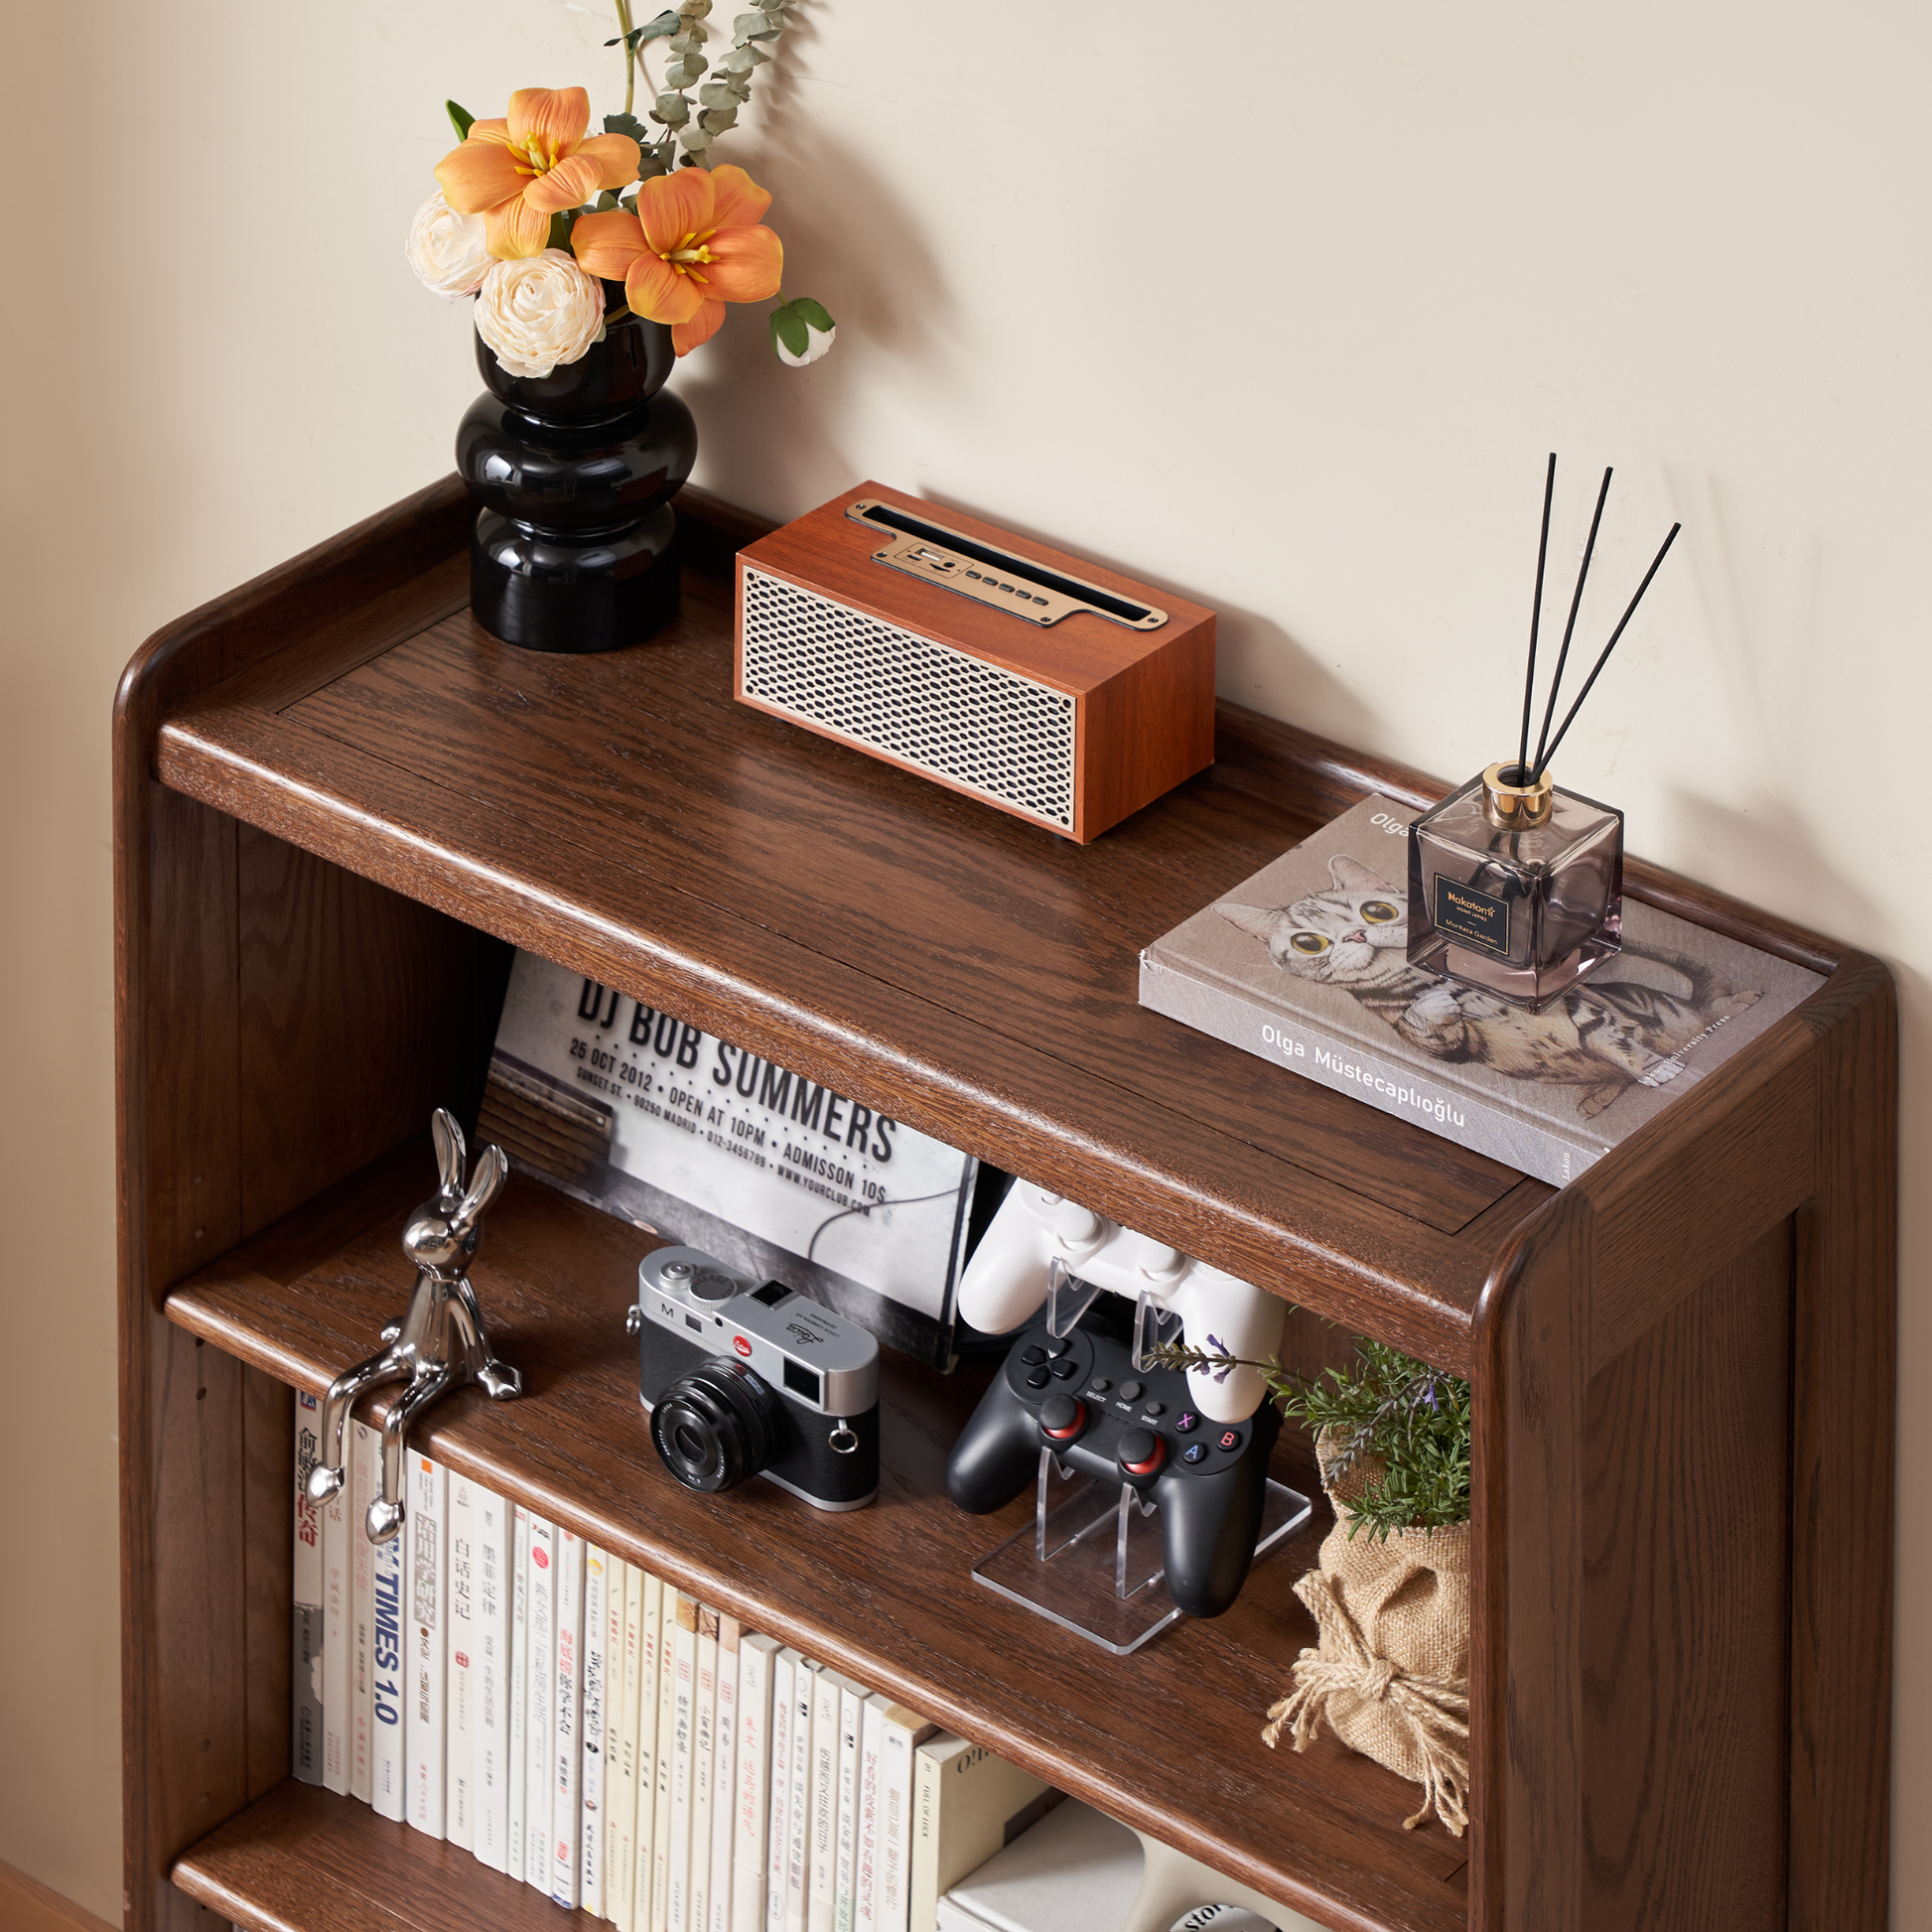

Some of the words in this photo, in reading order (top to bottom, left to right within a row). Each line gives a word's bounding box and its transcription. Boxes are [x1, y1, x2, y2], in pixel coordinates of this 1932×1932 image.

[1448, 892, 1496, 917] Nakatomi
[1474, 930, 1498, 945] Garden
[1262, 1025, 1305, 1057] Olga
[1664, 1033, 1709, 1065] University
[1706, 1015, 1730, 1033] Press
[578, 978, 620, 1029] DJ
[628, 1003, 702, 1069] BOB
[713, 1041, 897, 1163] SUMMERS
[570, 1038, 588, 1059] 25
[591, 1048, 617, 1073] OCT
[619, 1062, 652, 1092] 2012
[669, 1087, 704, 1117] OPEN
[707, 1106, 725, 1127] AT
[731, 1117, 765, 1148] 10PM
[782, 1143, 855, 1189] ADMISSON
[862, 1178, 887, 1203] 10$
[577, 1066, 610, 1090] SUNSET
[610, 1082, 622, 1099] ST.
[633, 1094, 660, 1117] 90250
[663, 1109, 697, 1134] MADRID
[707, 1131, 766, 1168] 012-3456789
[776, 1164, 871, 1217] WWW.YOURCLUB.COM
[661, 1303, 674, 1318] M
[1085, 1390, 1107, 1403] SELECT
[1115, 1401, 1133, 1413] HOME
[1141, 1414, 1159, 1427] START
[1177, 1413, 1193, 1429] X
[1185, 1444, 1200, 1459] A
[1220, 1431, 1236, 1447] B
[454, 1538, 471, 1620] 白话史记
[482, 1543, 496, 1616] 墨菲定律
[375, 1573, 399, 1672] TIMES
[375, 1679, 399, 1725] 1.0
[676, 1694, 689, 1754] 扬州画舫录
[699, 1705, 712, 1752] 小窗幽记
[722, 1717, 731, 1746] 周易
[745, 1717, 757, 1749] 朱文
[743, 1760, 757, 1837] 达马的语气
[922, 1805, 930, 1817] OF
[859, 1749, 879, 1921] 好看的皮囊不如有趣的灵魂
